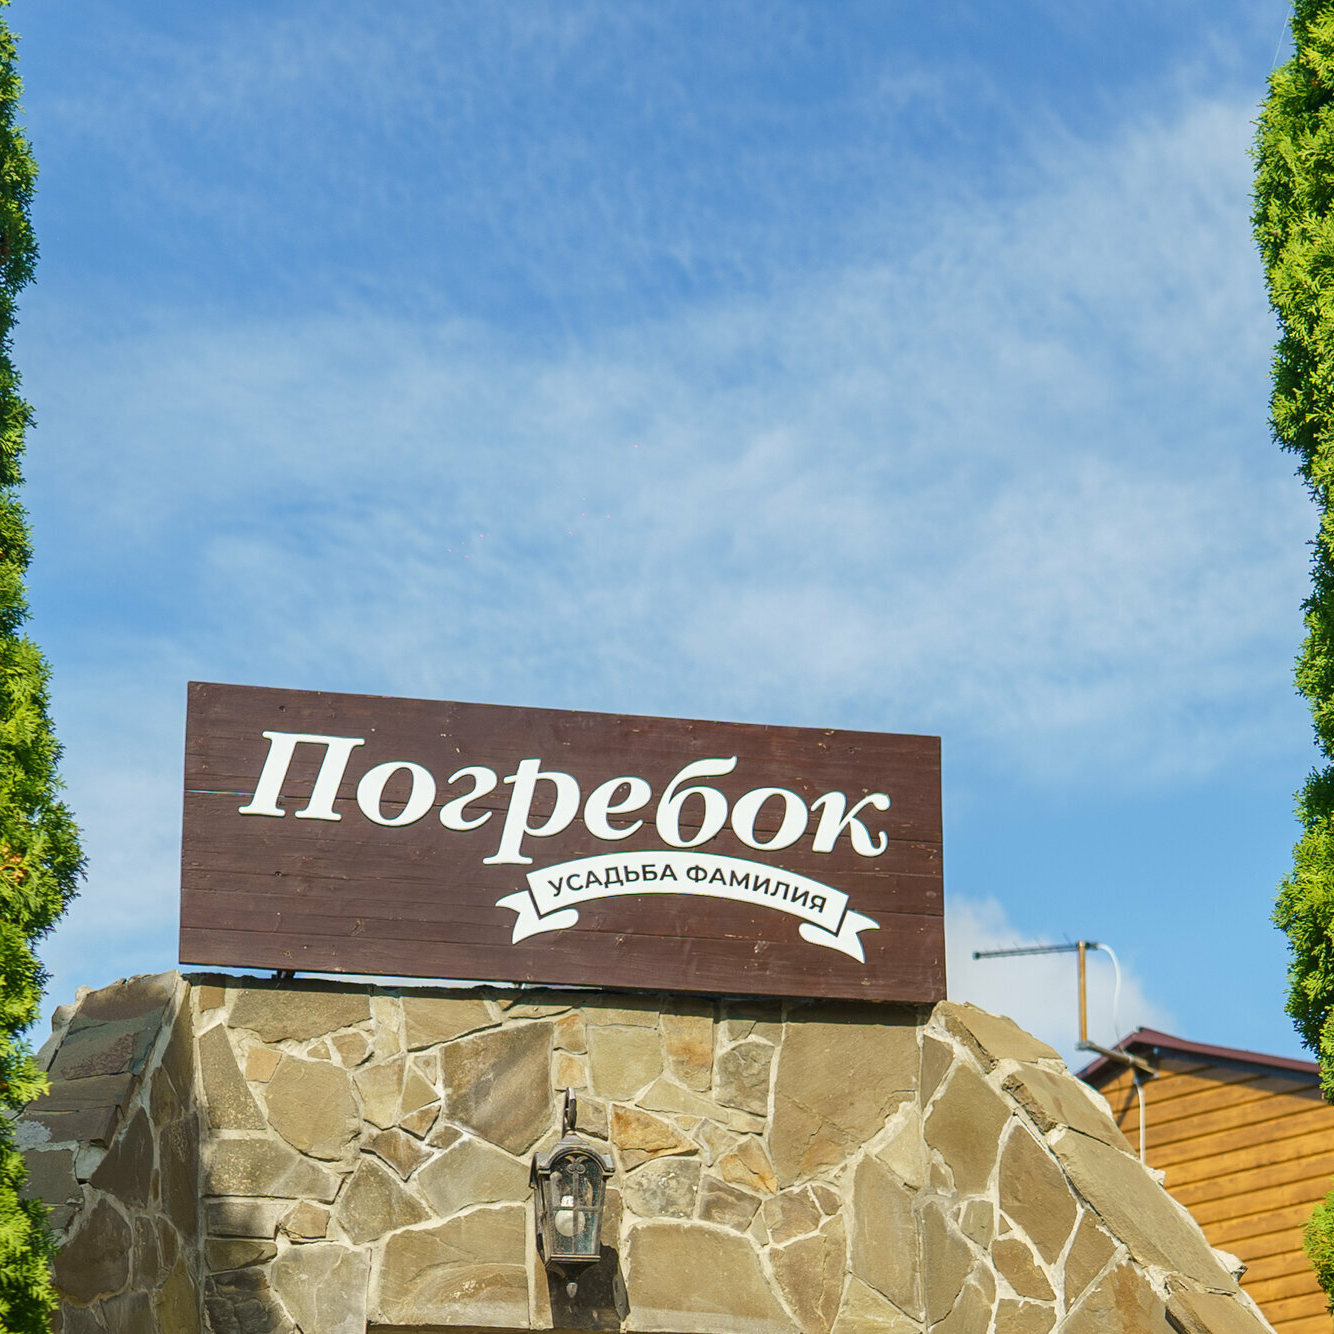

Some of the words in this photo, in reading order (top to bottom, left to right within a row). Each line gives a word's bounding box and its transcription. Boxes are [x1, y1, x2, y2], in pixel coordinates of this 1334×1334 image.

[238, 730, 891, 865] Погребок
[547, 864, 678, 897] УСАДЬБА
[686, 865, 827, 914] ФАМИЛИЯ
